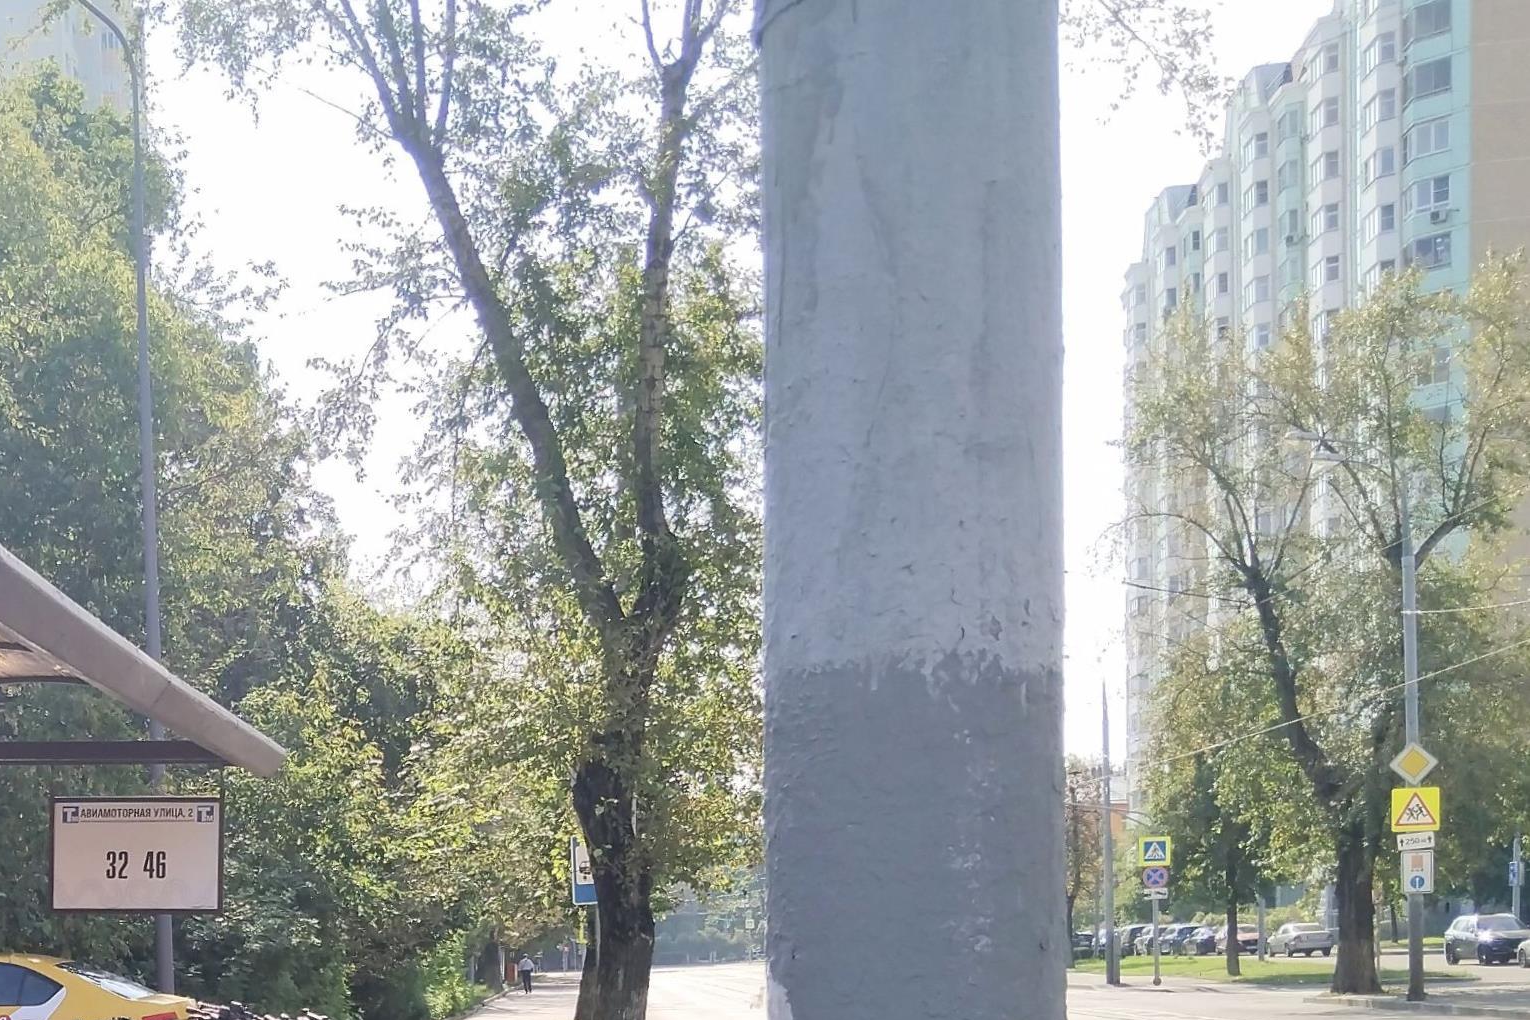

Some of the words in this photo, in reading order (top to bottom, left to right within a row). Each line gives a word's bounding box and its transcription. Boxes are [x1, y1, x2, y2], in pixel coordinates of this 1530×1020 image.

[188, 808, 193, 817] 2
[106, 851, 128, 879] 32
[143, 851, 166, 879] 46
